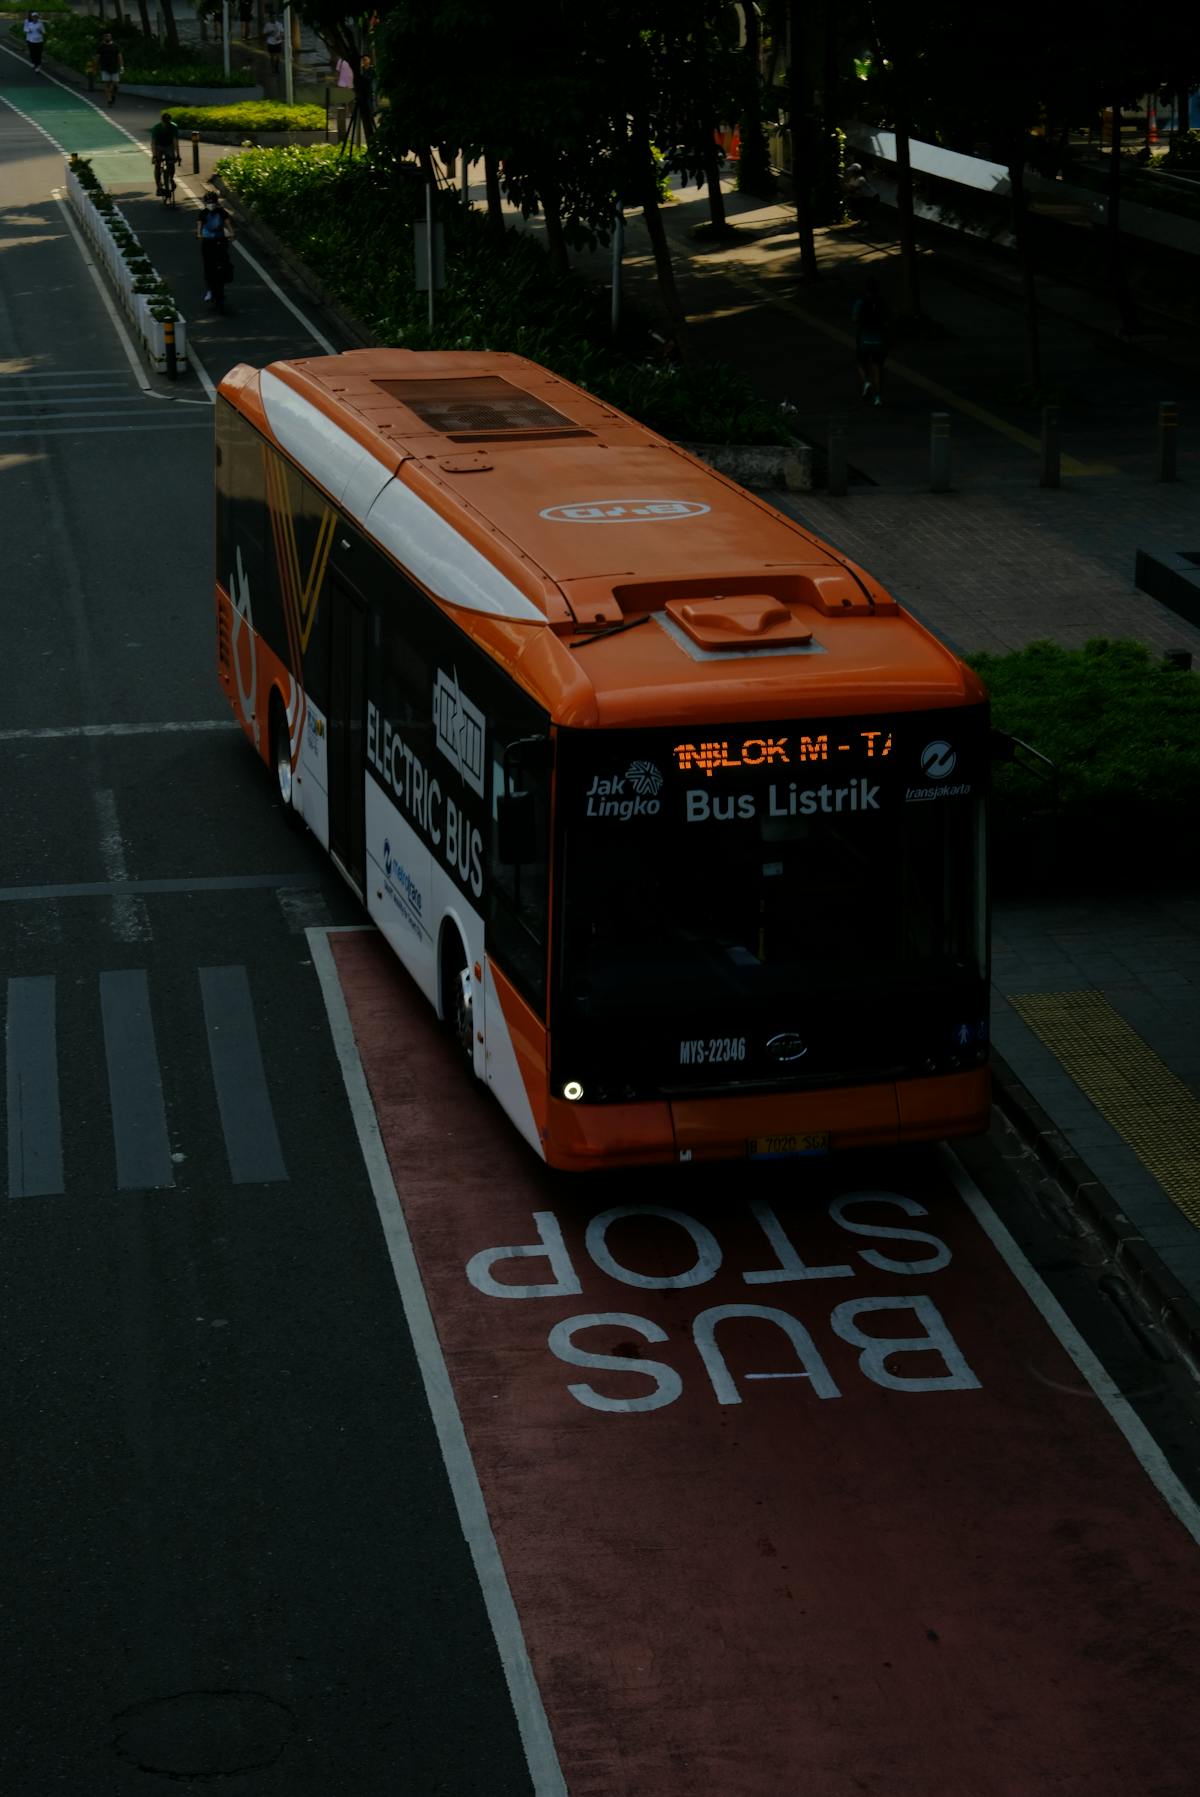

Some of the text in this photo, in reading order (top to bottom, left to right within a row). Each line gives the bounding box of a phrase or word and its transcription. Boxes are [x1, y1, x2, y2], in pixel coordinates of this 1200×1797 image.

[800, 735, 828, 761] M
[366, 699, 442, 846] ELECTRIC
[445, 796, 484, 898] BUS
[586, 775, 625, 798] Jak
[686, 778, 881, 823] Bus Listrik
[586, 796, 661, 821] Lingko
[679, 1036, 747, 1066] MYS-22346
[465, 1190, 953, 1300] STOP
[547, 1294, 984, 1413] BUS
